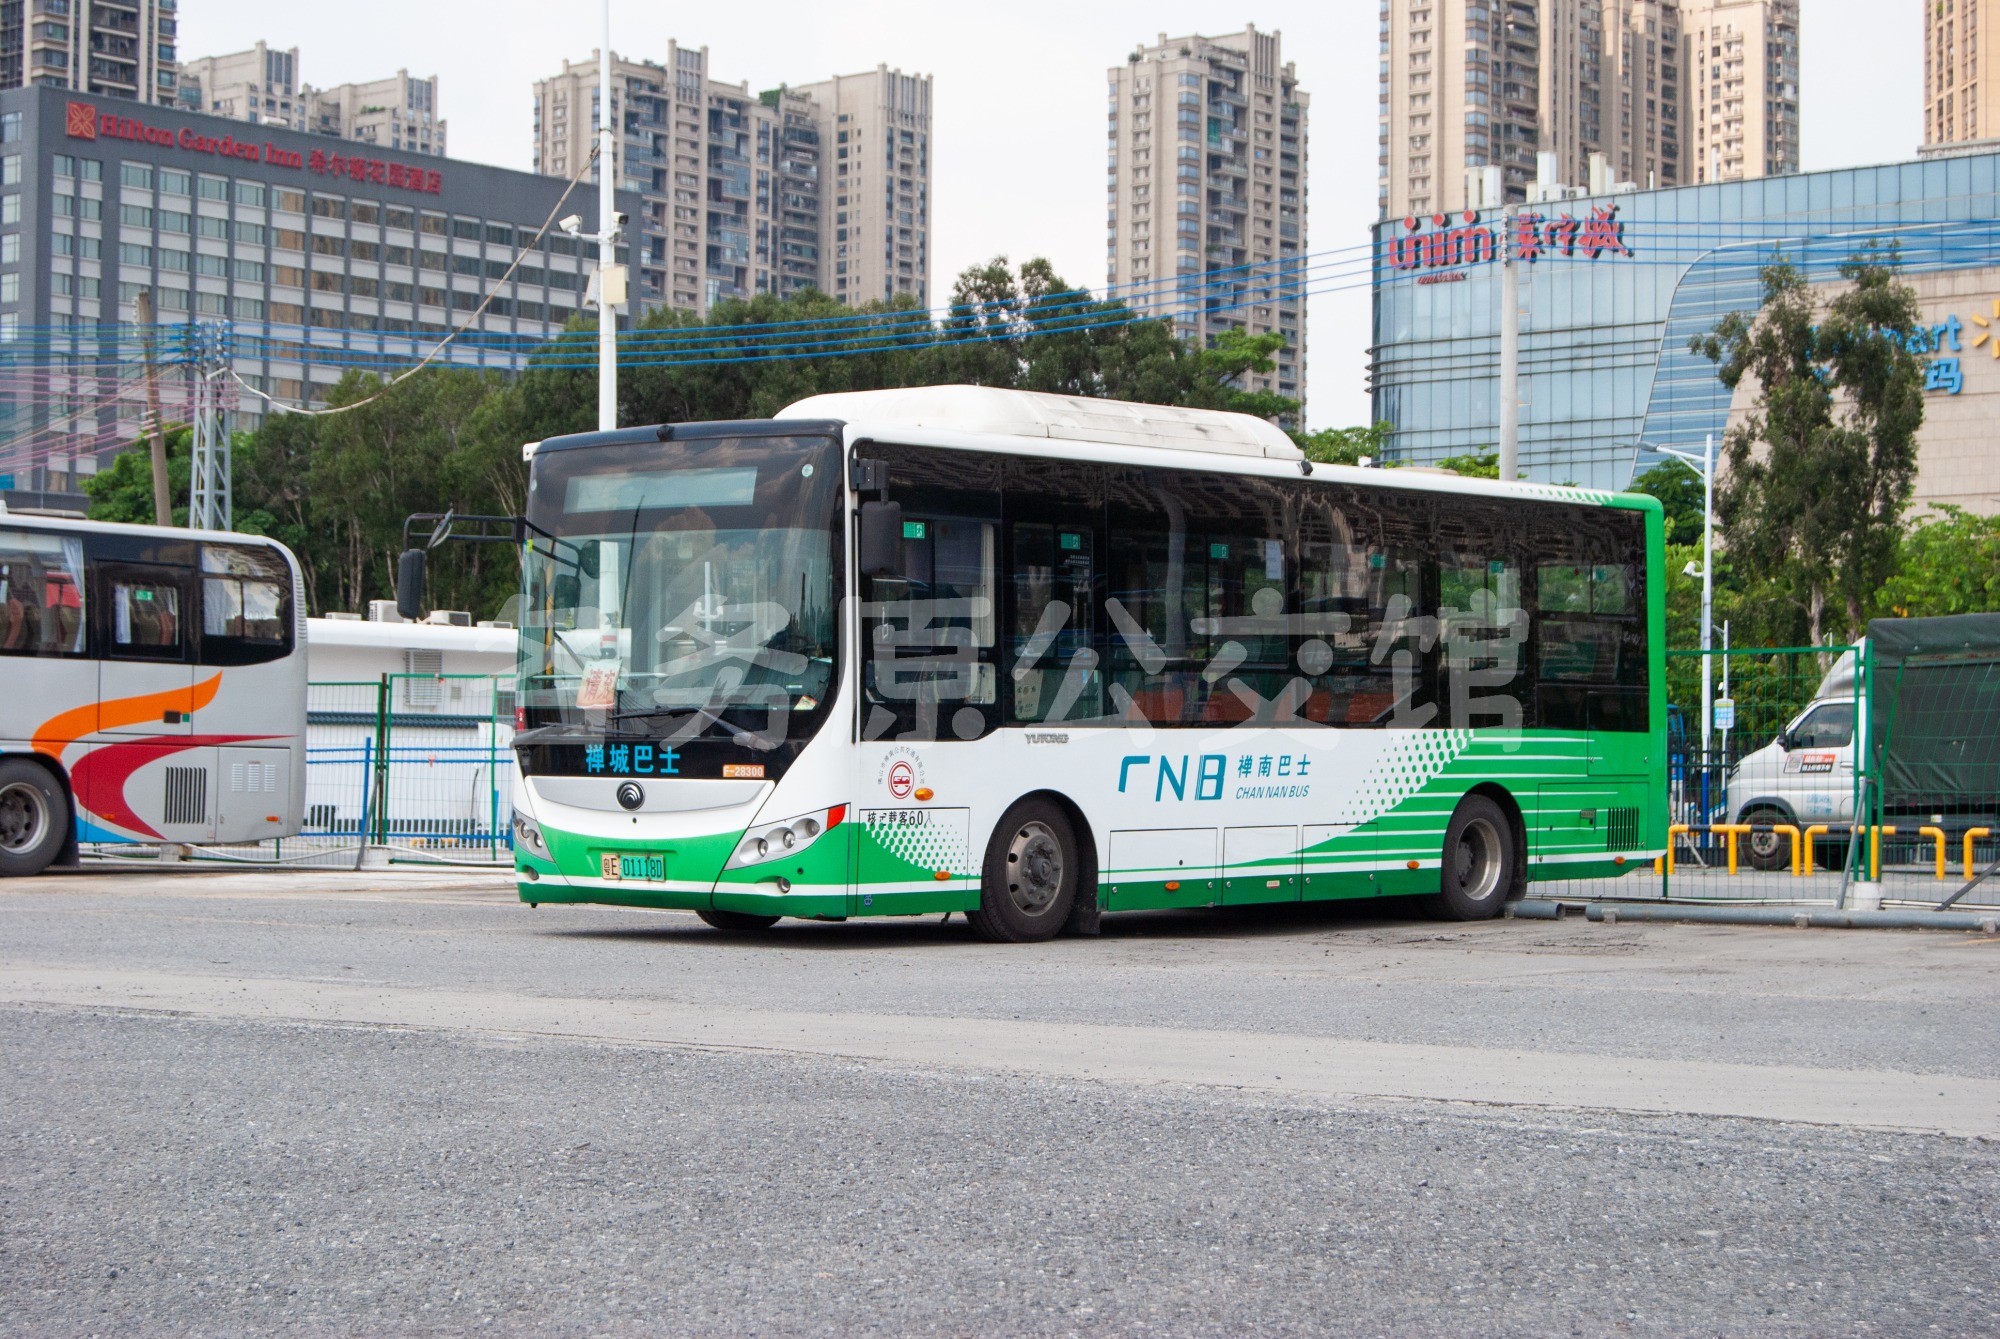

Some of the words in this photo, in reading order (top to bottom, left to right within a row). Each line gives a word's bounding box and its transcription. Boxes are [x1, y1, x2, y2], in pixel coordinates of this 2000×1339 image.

[101, 114, 174, 148] Hilton
[178, 127, 260, 162] Garden
[264, 141, 303, 168] Inn
[310, 148, 443, 195] 希尔顿花园酒店
[1024, 733, 1069, 744] YUTONG
[585, 744, 681, 775] 禅城巴士
[722, 766, 763, 777] F-28300
[1237, 754, 1311, 778] 禅南巴士
[1235, 786, 1265, 800] CHAN
[1265, 785, 1288, 799] NAN
[1288, 784, 1310, 798] BUS
